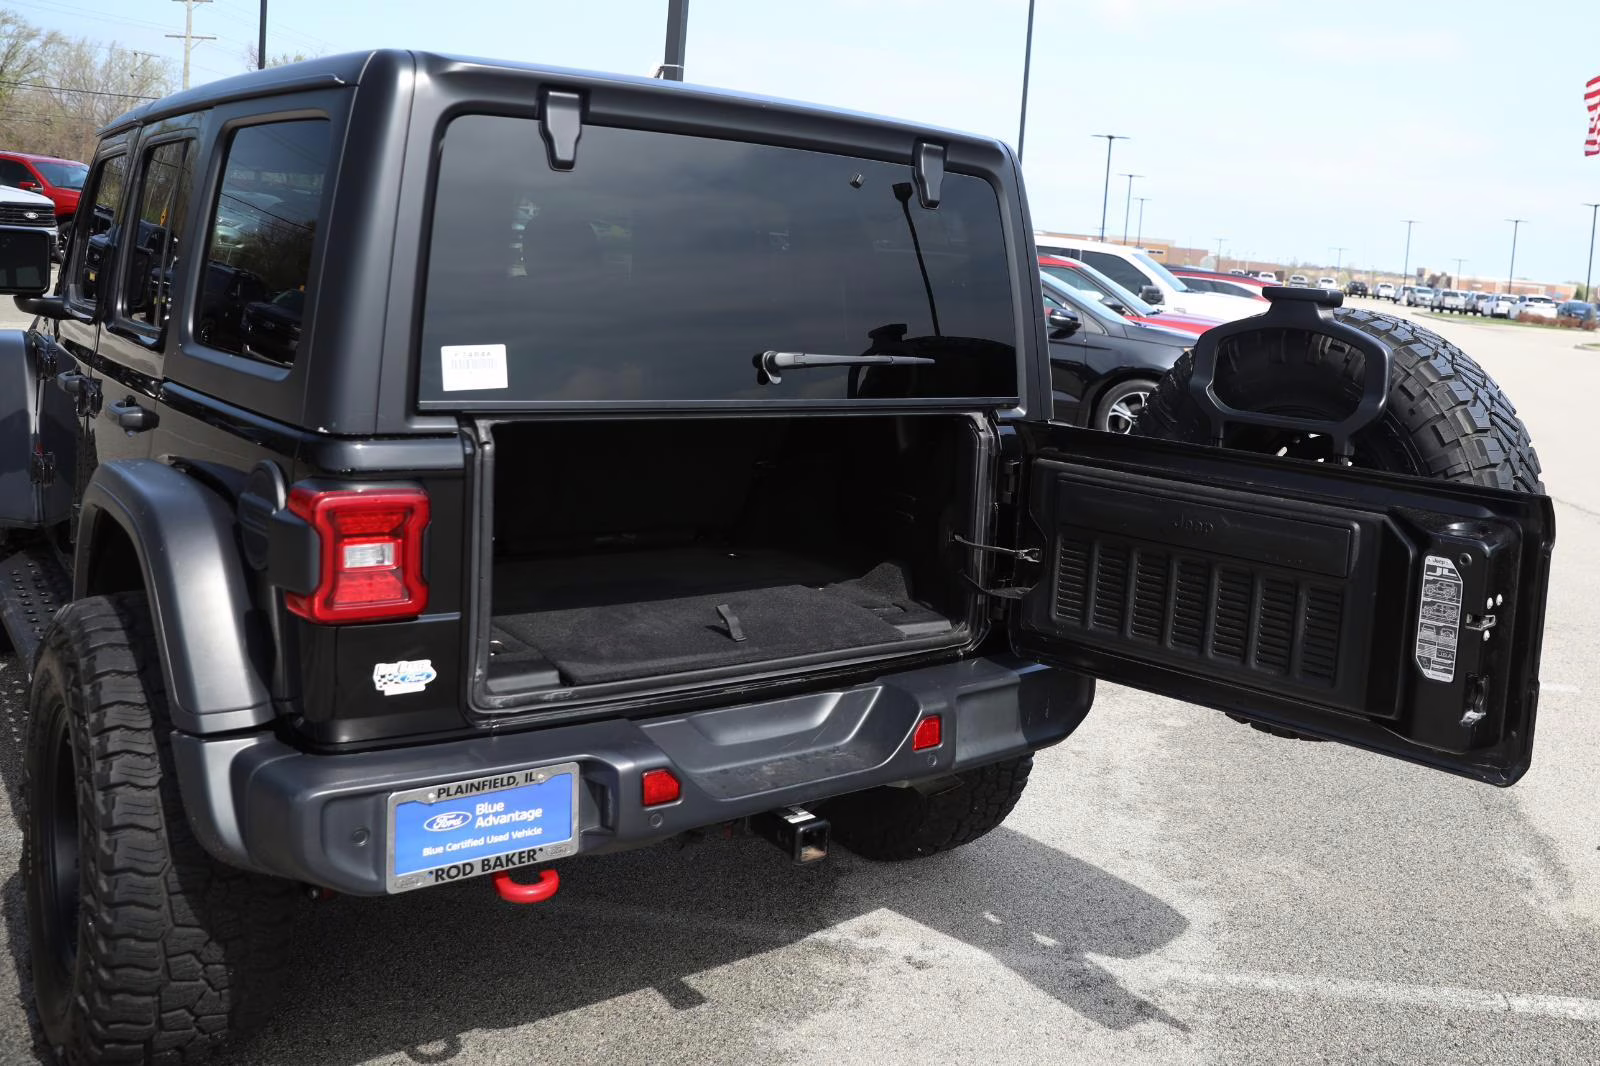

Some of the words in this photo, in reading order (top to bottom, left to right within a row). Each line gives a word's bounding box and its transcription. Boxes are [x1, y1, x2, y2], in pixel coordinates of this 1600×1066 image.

[437, 775, 519, 798] PLAINFIELD,
[524, 771, 535, 783] IL
[475, 801, 505, 815] Blue
[475, 808, 543, 829] Advantage
[422, 846, 443, 857] Blue
[446, 837, 484, 851] Certified
[486, 833, 509, 844] Used
[512, 827, 543, 840] Vehicle
